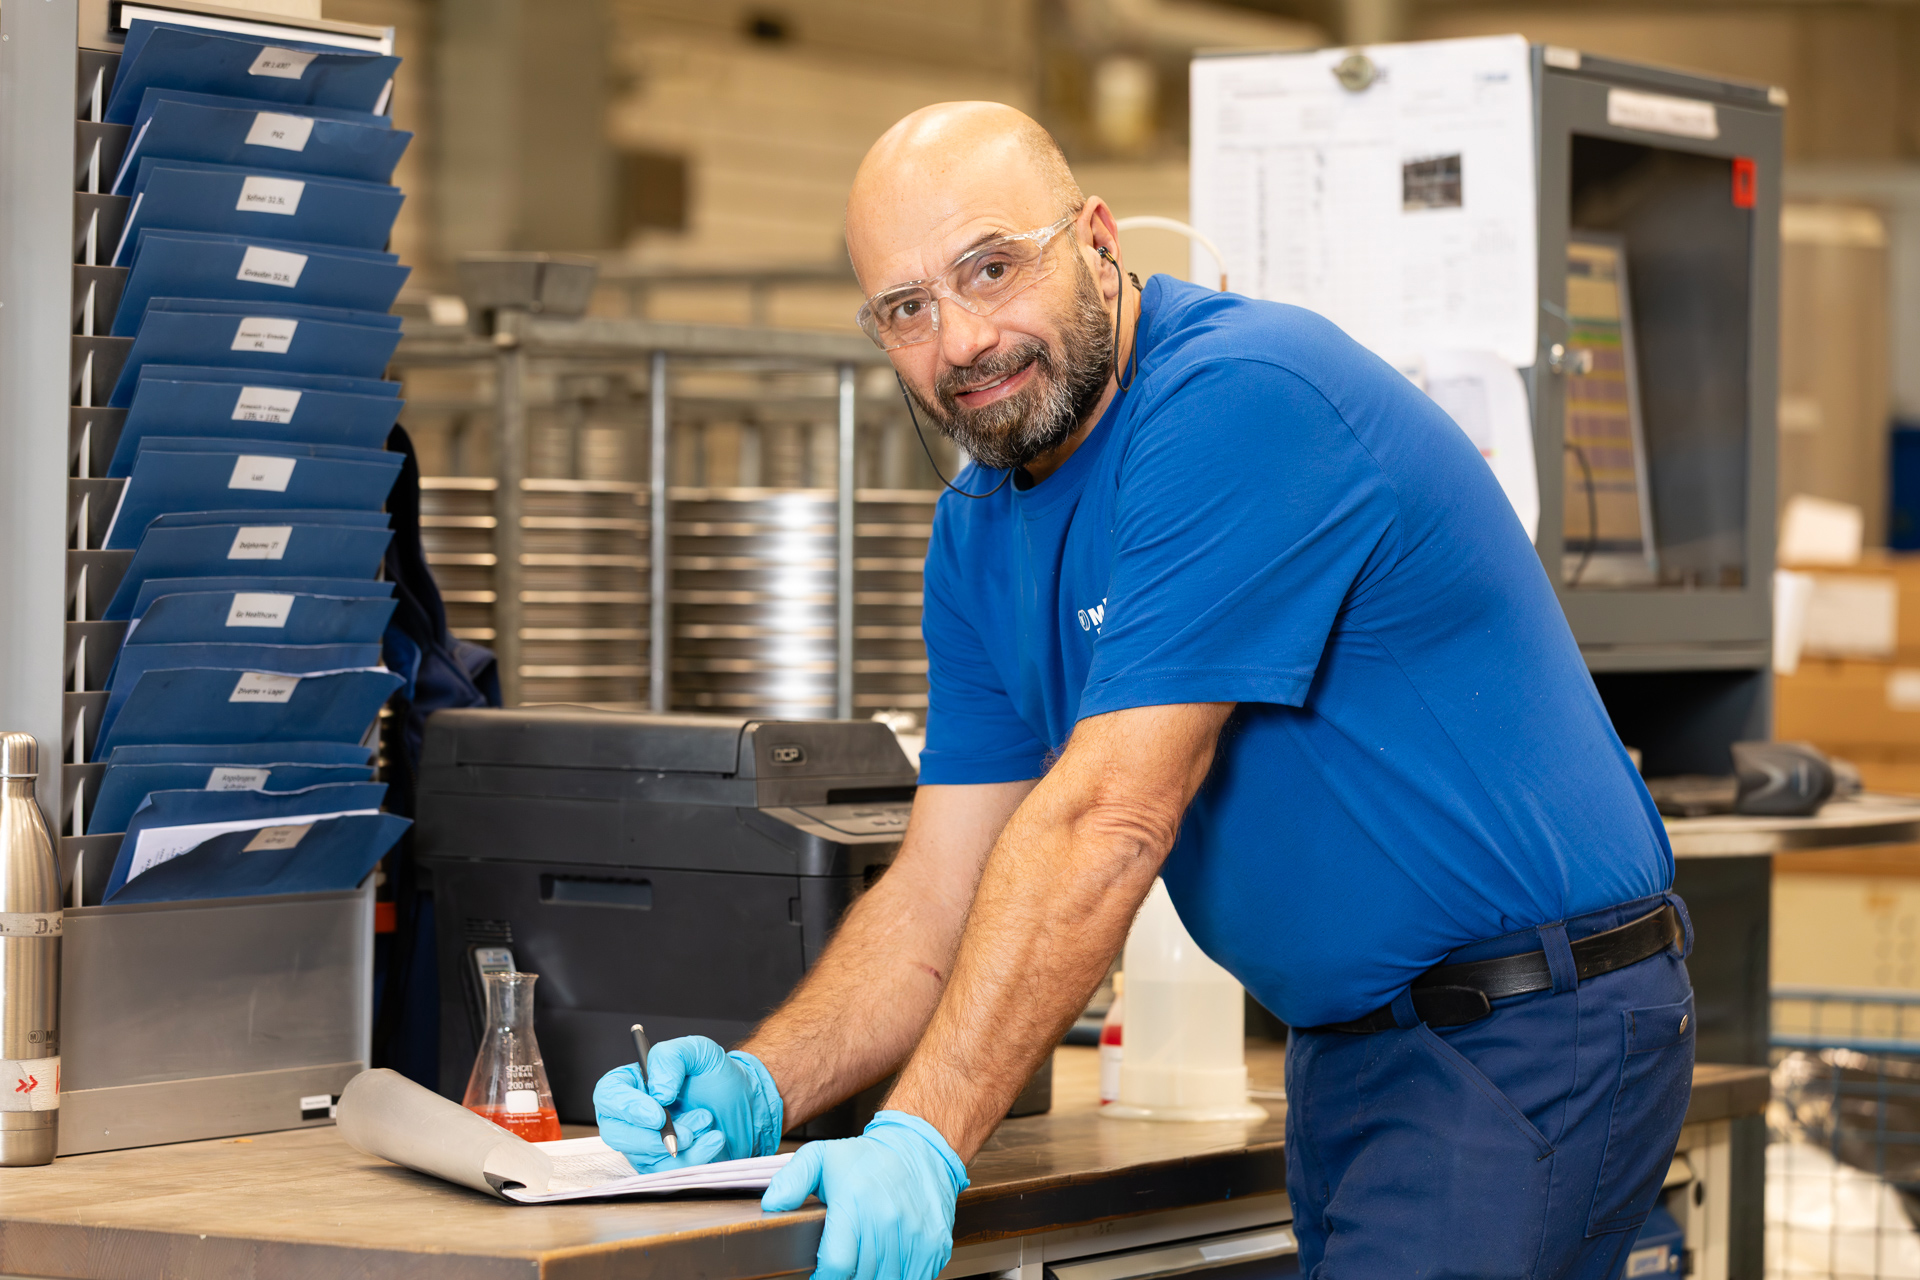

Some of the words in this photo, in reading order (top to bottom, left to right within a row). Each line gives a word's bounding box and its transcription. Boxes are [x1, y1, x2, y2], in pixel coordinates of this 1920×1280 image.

[1087, 598, 1107, 626] M
[774, 748, 799, 762] DCP
[507, 1082, 523, 1090] 200
[524, 1081, 534, 1089] ml
